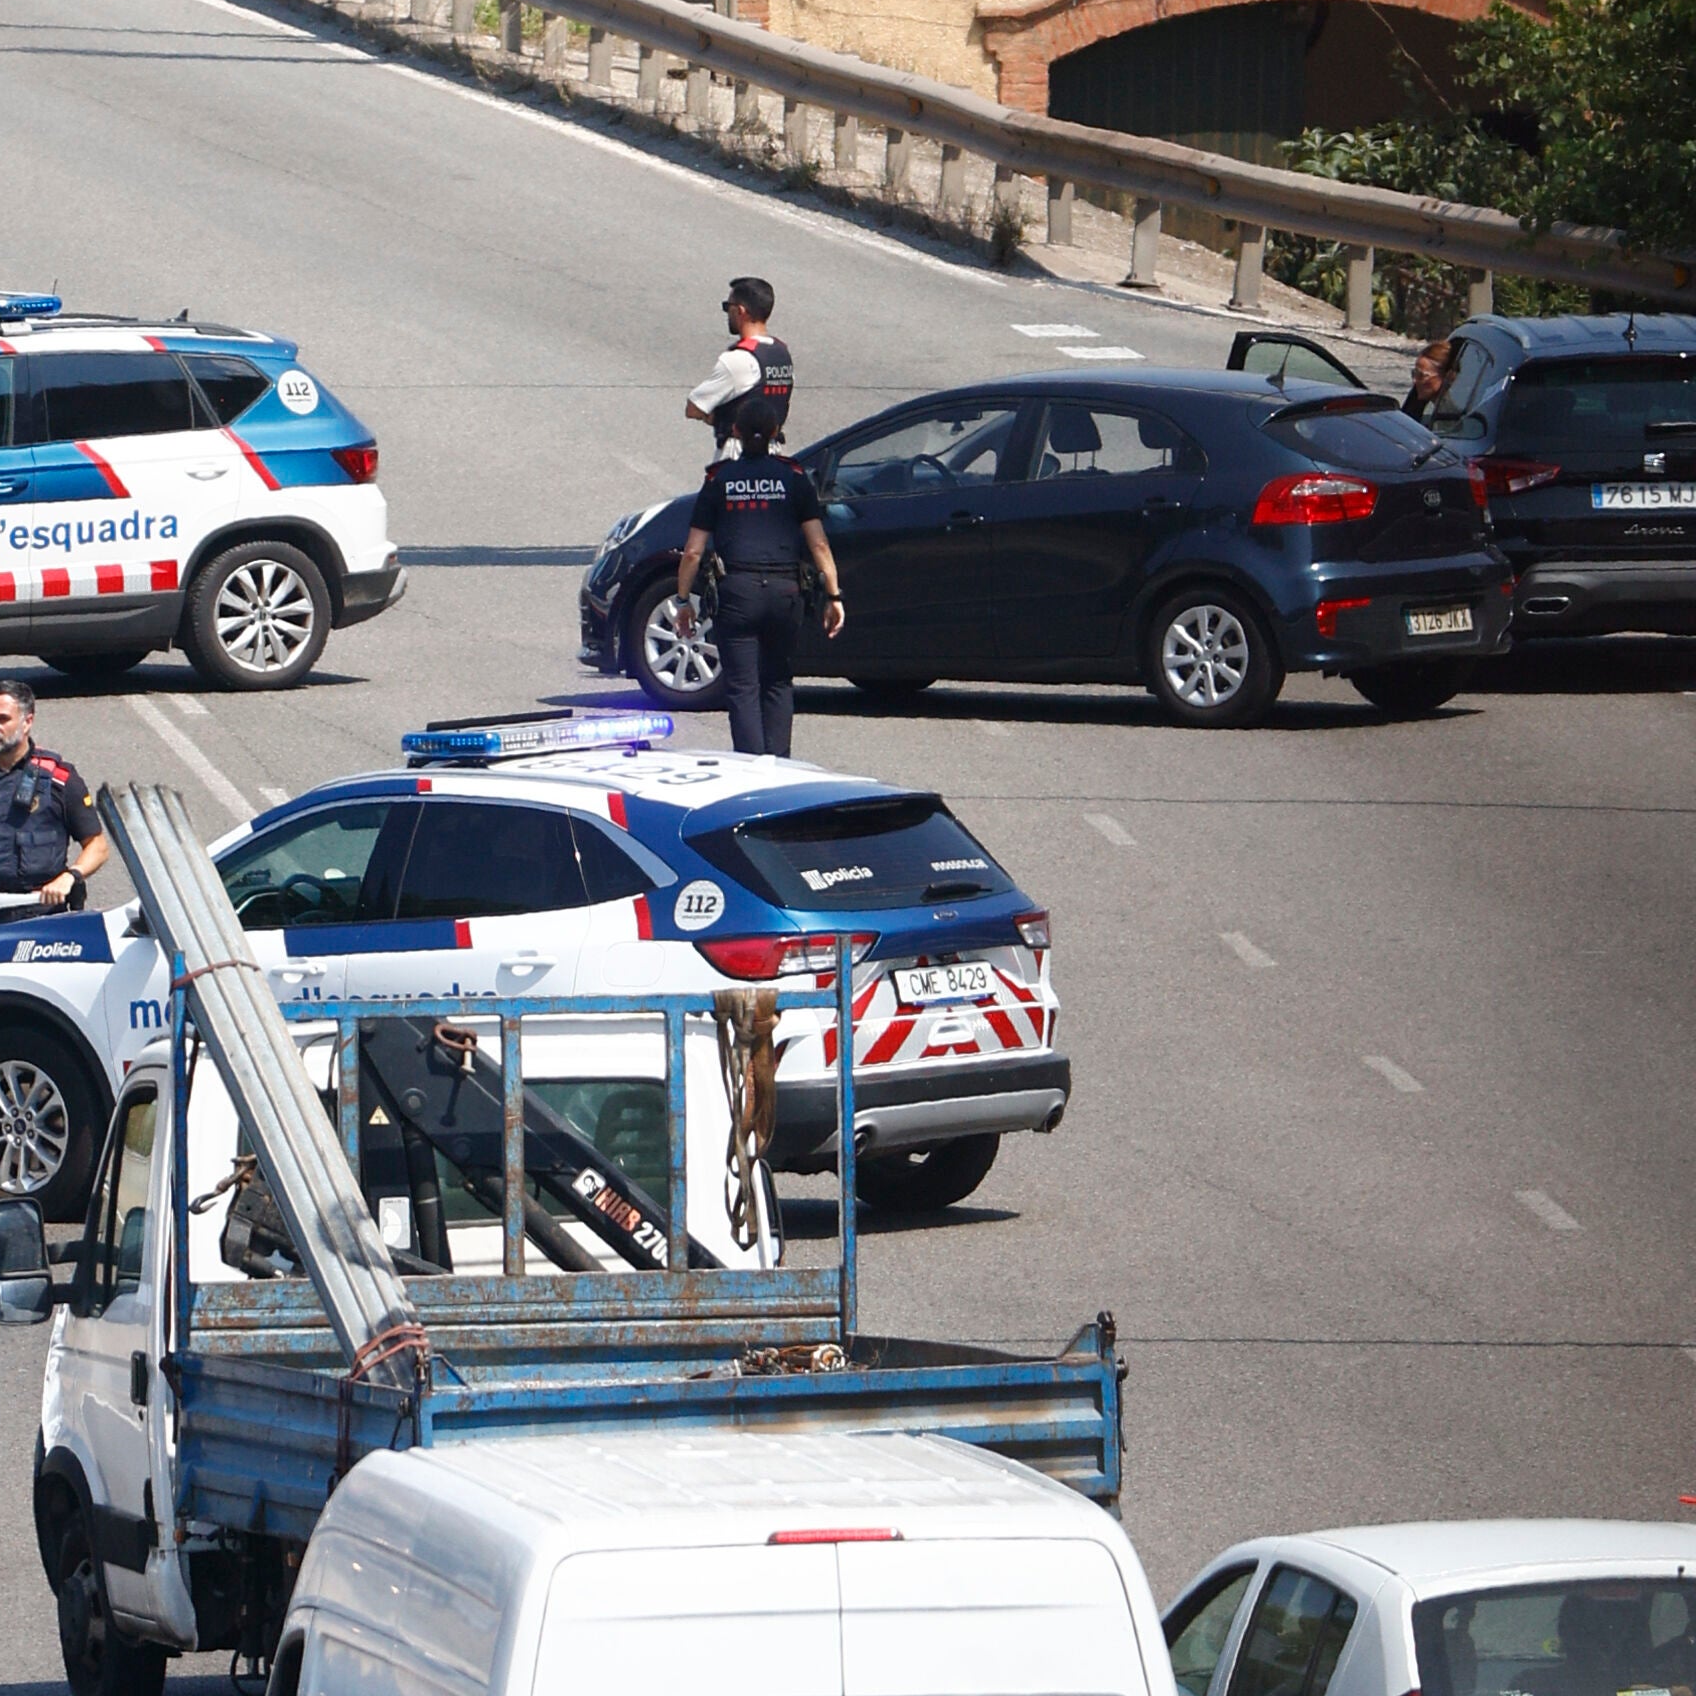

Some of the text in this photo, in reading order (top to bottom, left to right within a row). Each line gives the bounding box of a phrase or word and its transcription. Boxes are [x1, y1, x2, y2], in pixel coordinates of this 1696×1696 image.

[285, 382, 311, 396] 112
[725, 479, 786, 494] POLICIA
[1606, 486, 1662, 505] 7615
[1413, 612, 1443, 632] 3126
[821, 865, 874, 887] policia
[684, 895, 717, 913] 112
[31, 941, 83, 961] policia
[909, 966, 987, 997] CME 8429
[594, 1186, 642, 1232] HIAB
